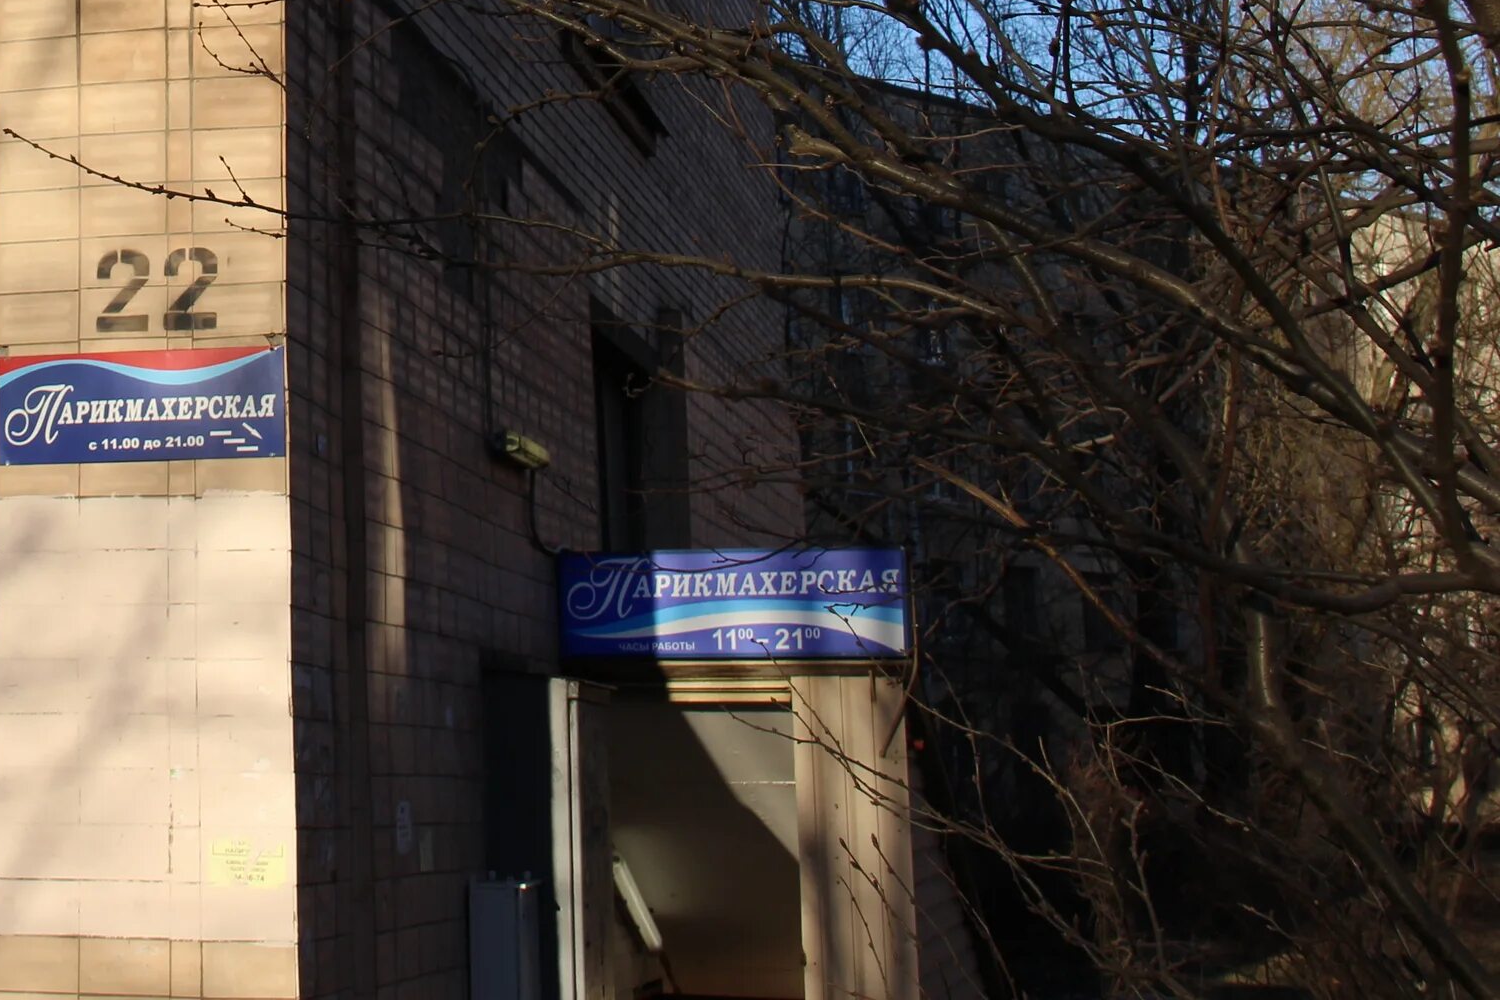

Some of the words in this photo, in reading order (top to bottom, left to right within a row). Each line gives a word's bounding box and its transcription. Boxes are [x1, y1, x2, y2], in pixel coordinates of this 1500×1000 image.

[96, 246, 218, 332] 22
[4, 384, 276, 446] ПАРИКМАХЕРСКАЯ
[101, 438, 140, 450] 11.00
[143, 439, 161, 451] до
[165, 435, 205, 448] 21.00
[566, 557, 900, 620] ПАРИКМАХЕРСКАЯ
[618, 642, 649, 651] ЧАСЫ
[652, 641, 696, 651] РАБОТЫ
